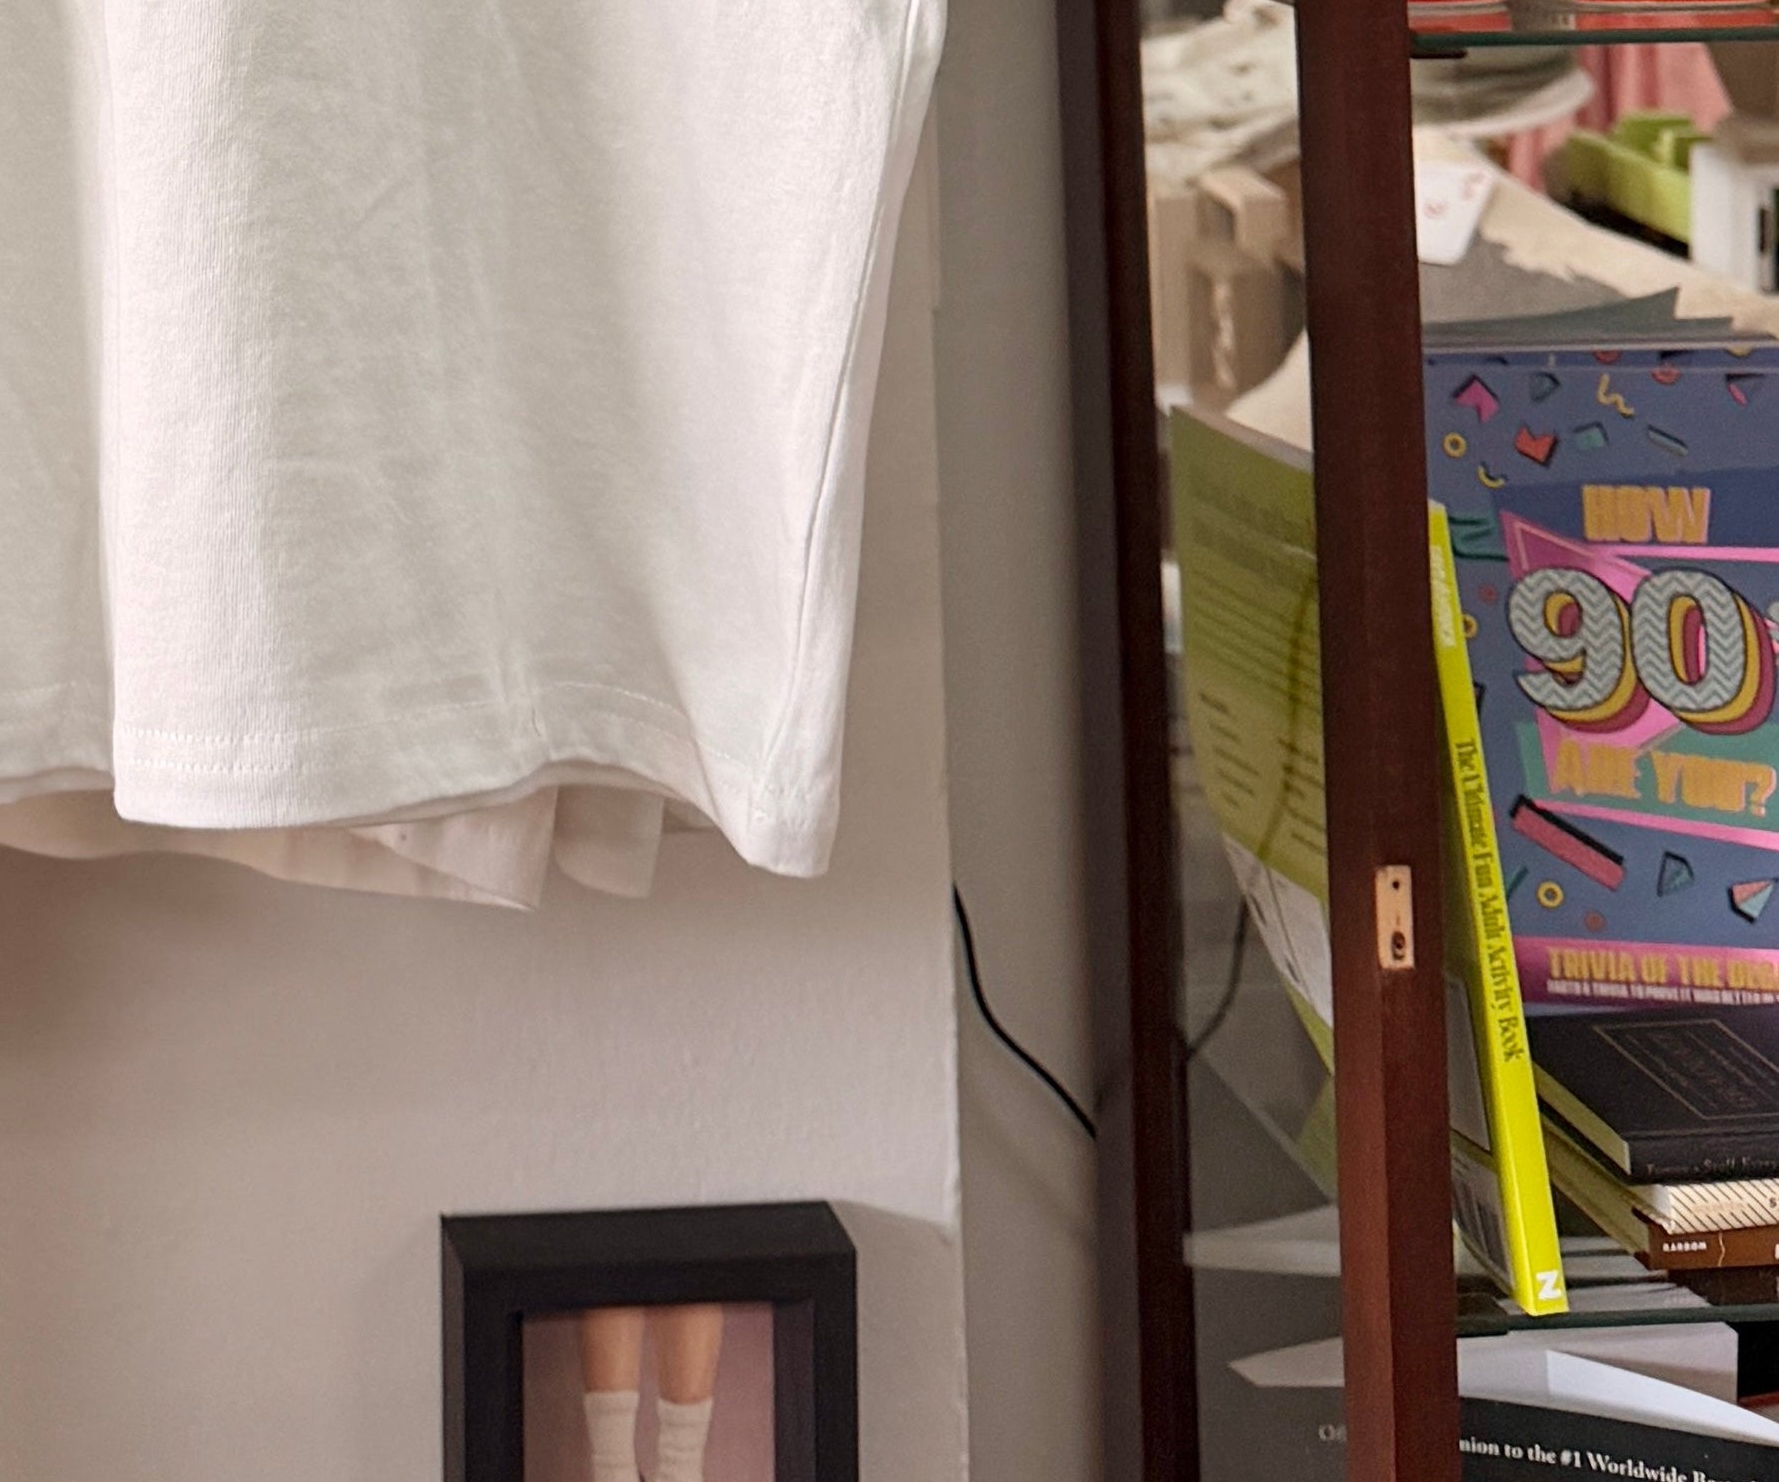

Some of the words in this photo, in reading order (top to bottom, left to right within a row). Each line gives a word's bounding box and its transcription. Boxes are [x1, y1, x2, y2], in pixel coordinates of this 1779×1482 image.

[1582, 485, 1711, 544] HOW
[1553, 740, 1641, 800] ARE
[1649, 748, 1777, 817] YOU?
[1473, 852, 1497, 889] Fun
[1498, 1017, 1524, 1062] Book
[1504, 1442, 1523, 1460] to
[1527, 1444, 1557, 1466] the
[1560, 1449, 1582, 1469] #1
[1587, 1452, 1688, 1482] Worldwide
